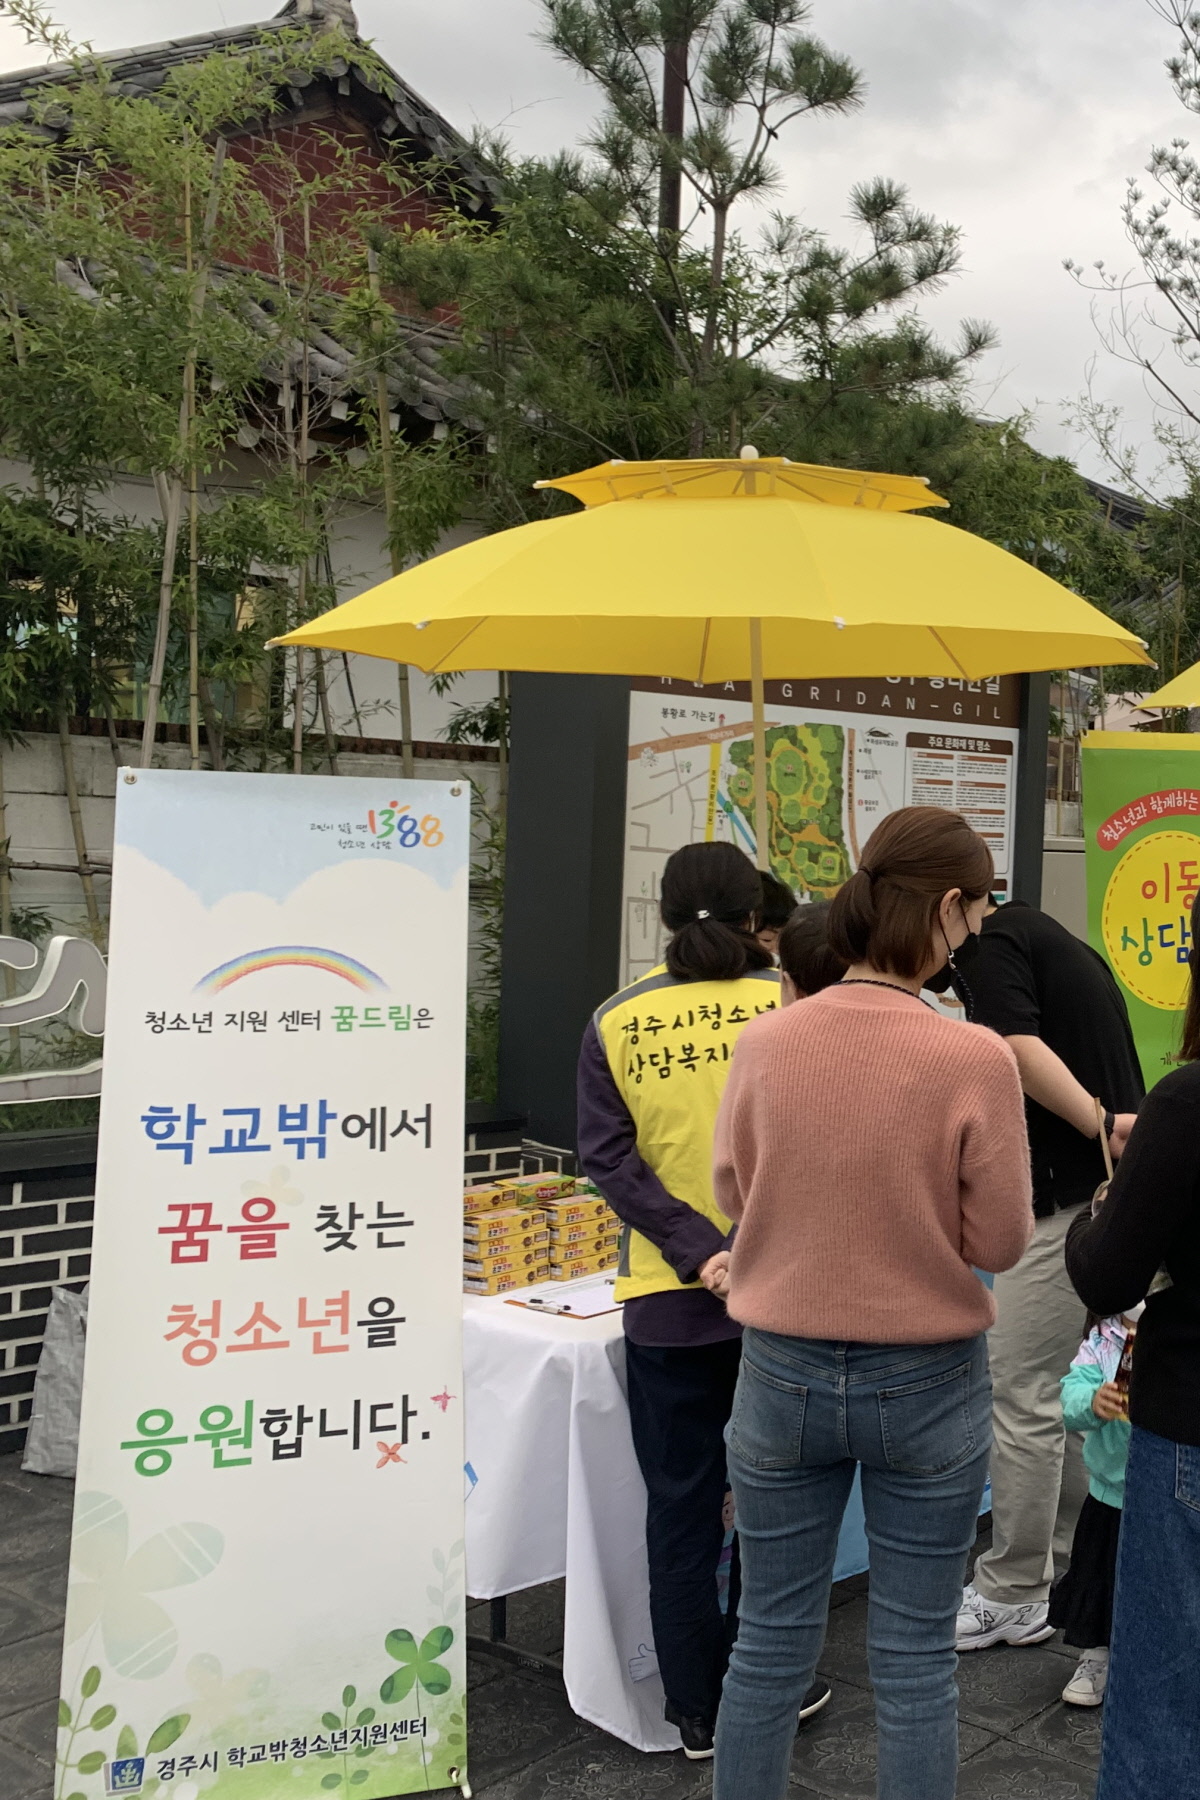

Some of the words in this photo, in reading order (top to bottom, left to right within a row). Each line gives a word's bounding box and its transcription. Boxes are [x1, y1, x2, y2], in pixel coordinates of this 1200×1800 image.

[661, 707, 687, 719] 봉황로
[691, 710, 716, 723] 가는길
[928, 736, 944, 748] 주요
[945, 737, 967, 750] 문화재
[968, 740, 976, 751] 및
[977, 740, 992, 752] 명소
[367, 803, 445, 849] 1388
[1102, 802, 1148, 841] 청소년과
[1149, 790, 1200, 814] 함께하는
[338, 839, 366, 849] 청소년
[370, 840, 392, 850] 상담
[145, 1010, 214, 1034] 청소년
[224, 1010, 268, 1032] 지원
[277, 1009, 321, 1032] 센터
[331, 1004, 434, 1032] 꿈드림은
[141, 1099, 432, 1165] 학교밖에서
[158, 1197, 290, 1264] 꿈을
[314, 1201, 415, 1253] 찾는
[163, 1290, 406, 1367] 청소년을
[120, 1395, 430, 1477] 응원합니다.
[156, 1751, 219, 1781] 경주시
[226, 1716, 428, 1769] 학교밖청소년지원센터
